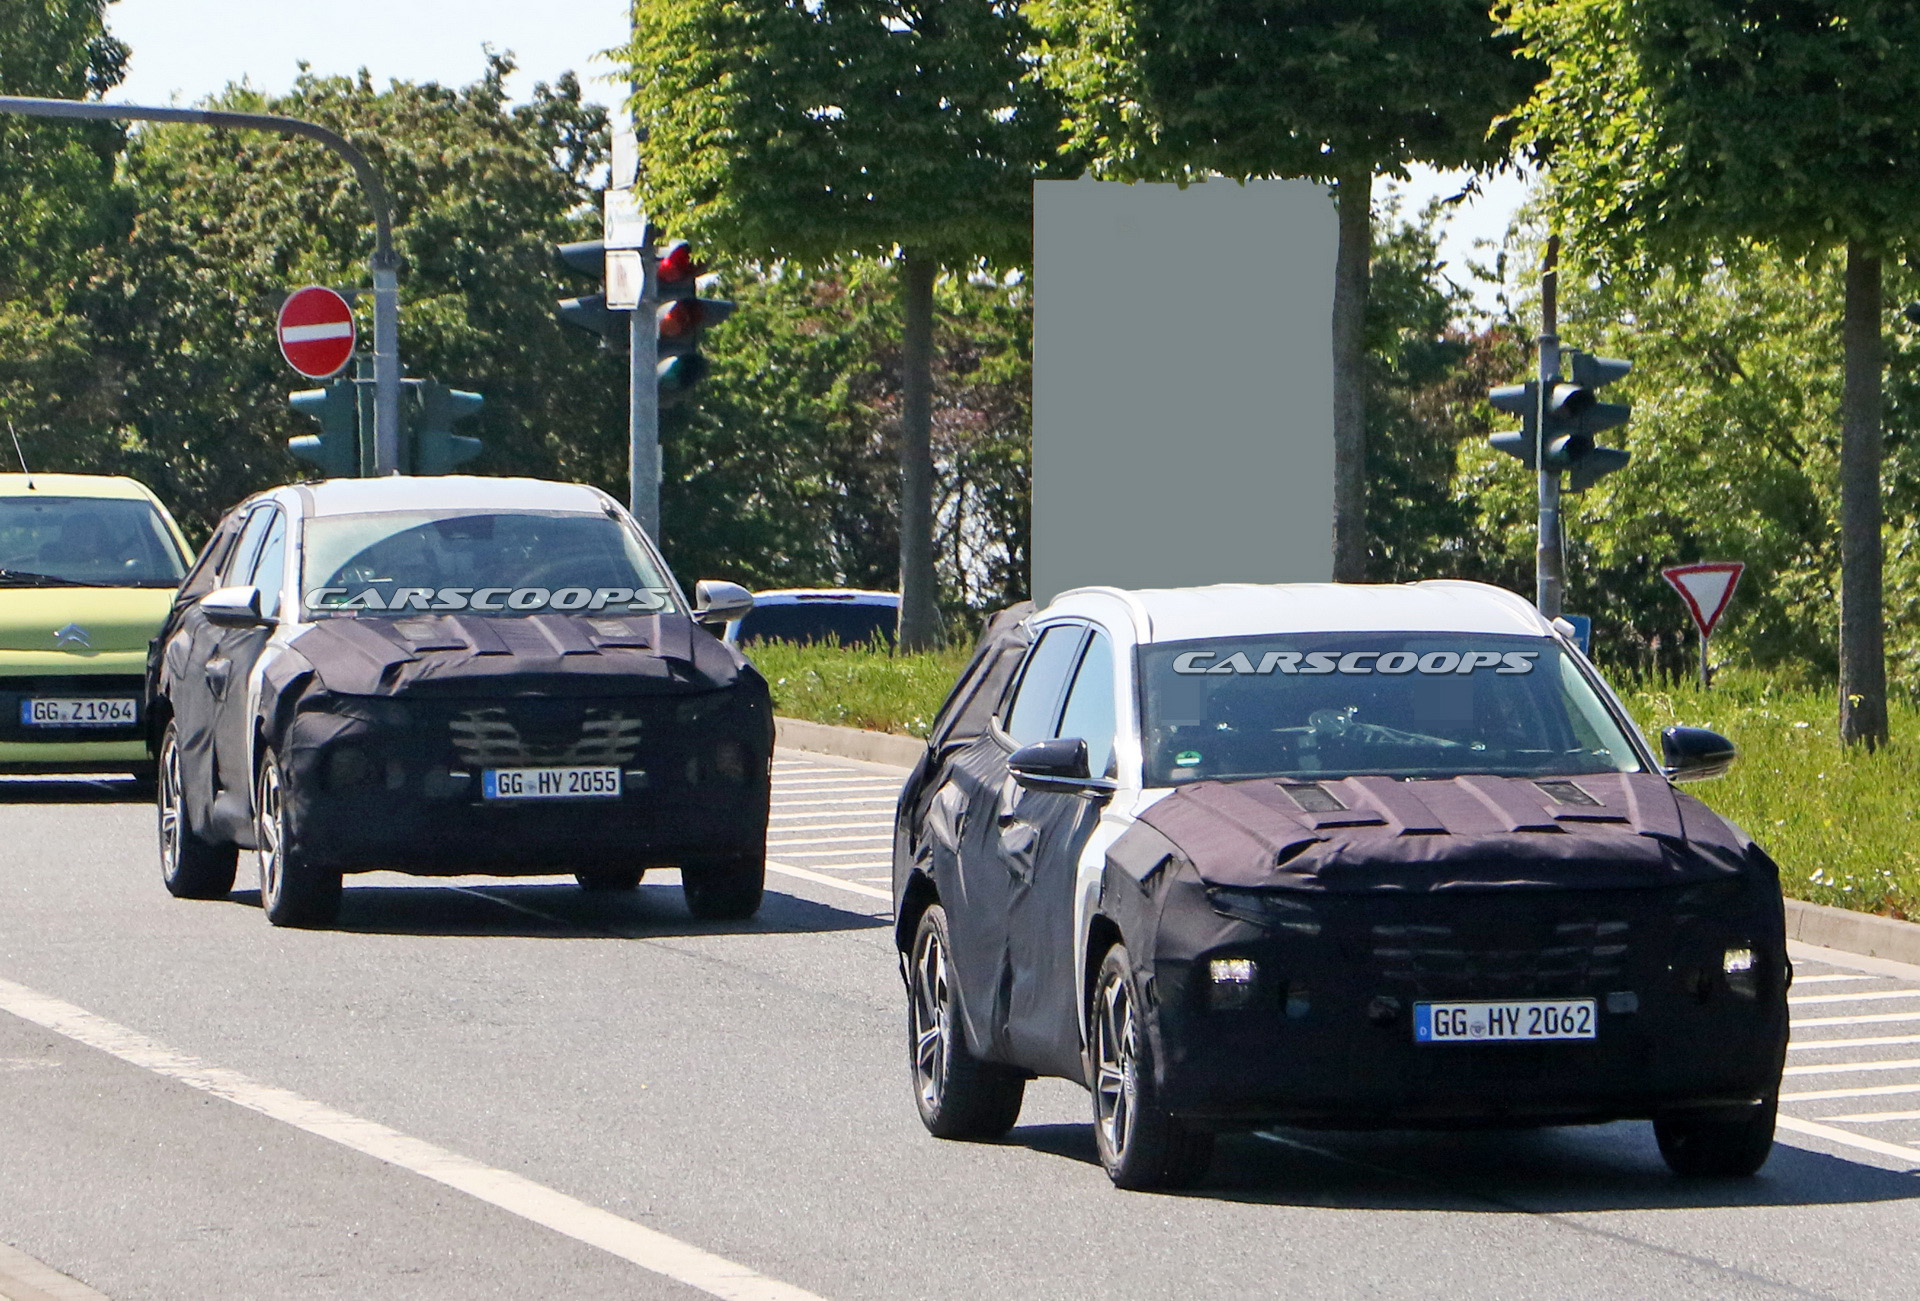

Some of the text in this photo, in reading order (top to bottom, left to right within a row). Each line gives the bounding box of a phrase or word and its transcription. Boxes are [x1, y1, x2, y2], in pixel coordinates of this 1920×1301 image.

[34, 702, 58, 720] GG
[498, 773, 522, 794] GG
[538, 772, 562, 794] HY
[569, 771, 616, 793] 2055
[1434, 1009, 1467, 1036] GG
[1488, 1007, 1520, 1036] HY
[1528, 1006, 1591, 1035] 2062
